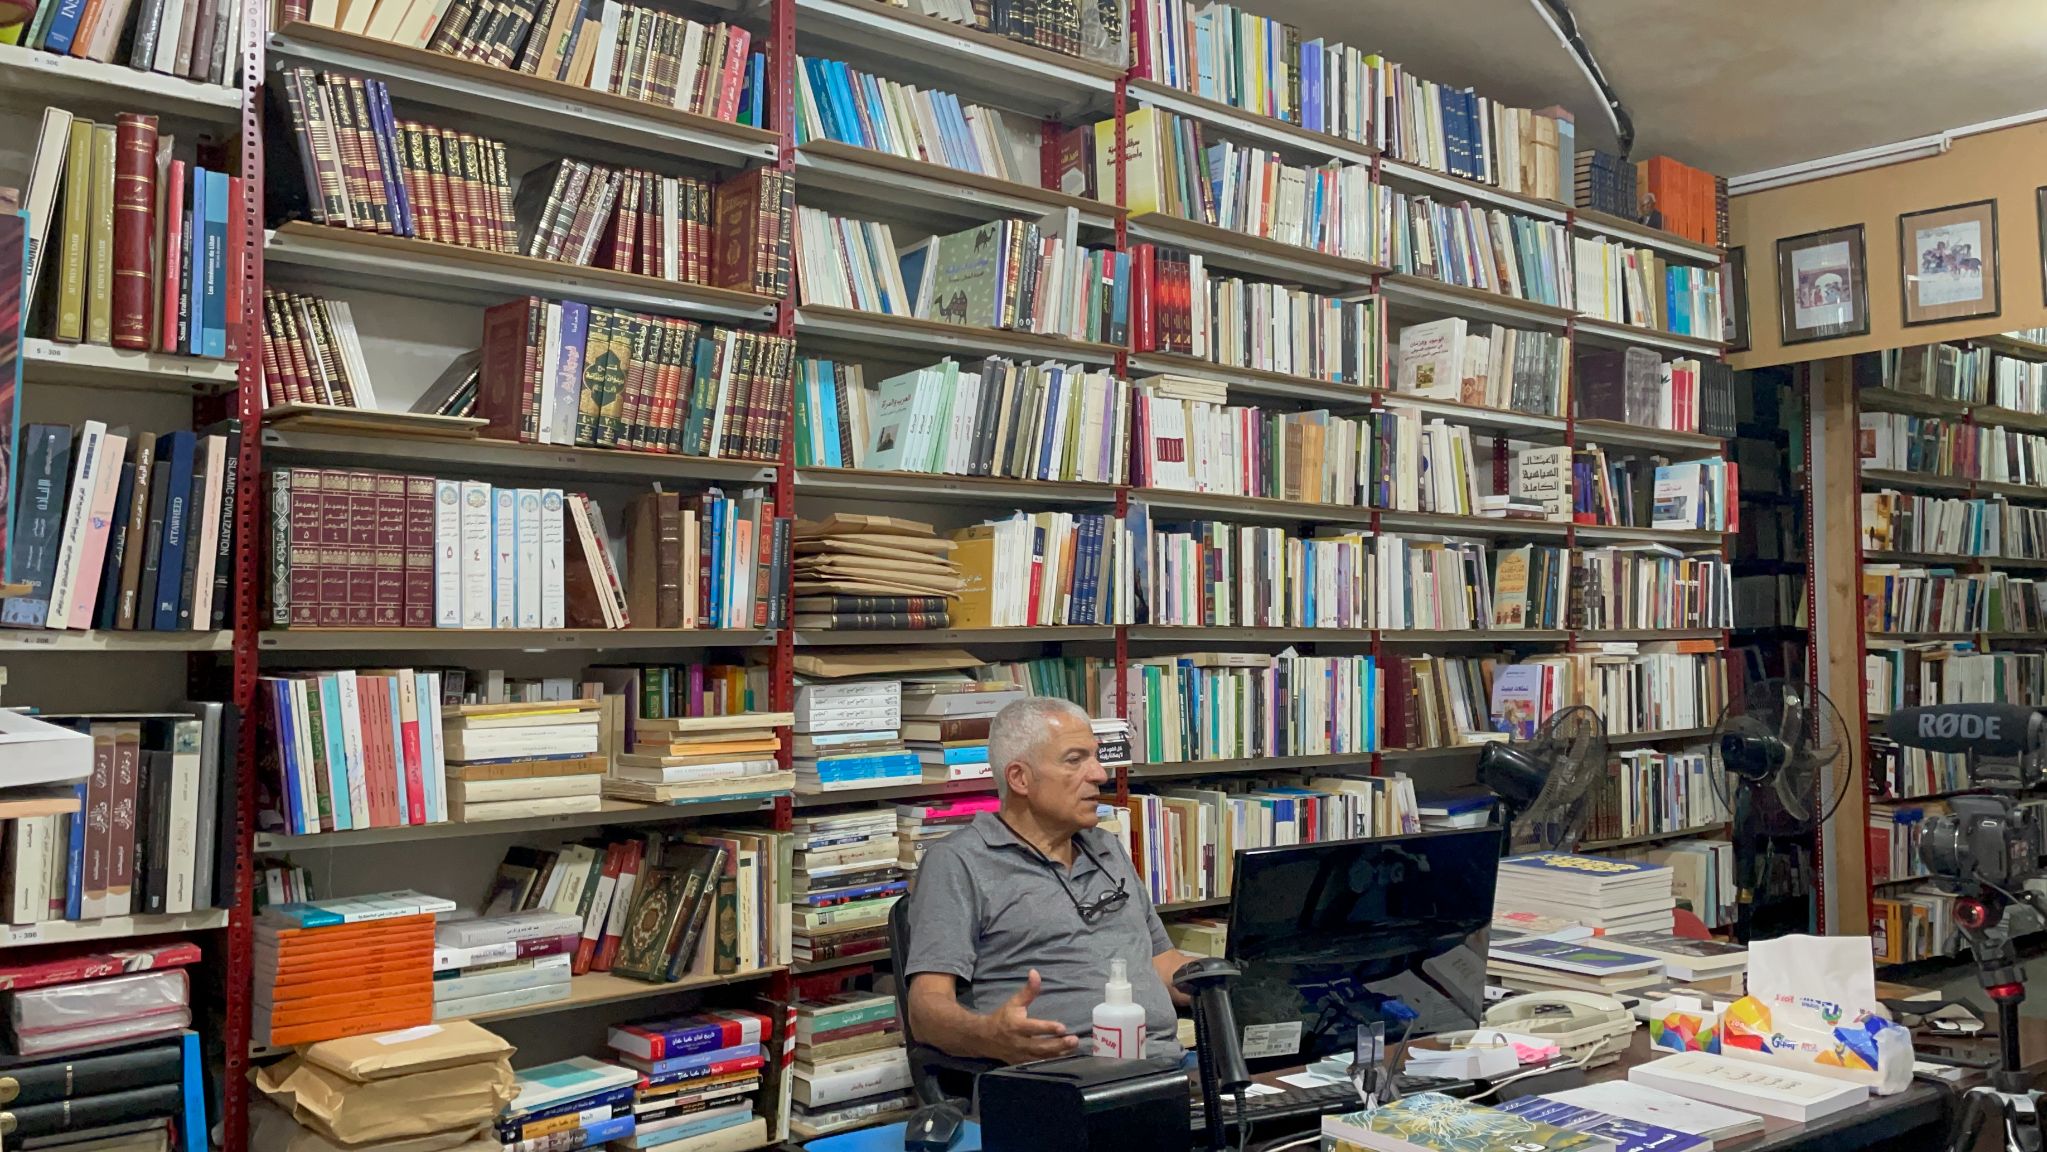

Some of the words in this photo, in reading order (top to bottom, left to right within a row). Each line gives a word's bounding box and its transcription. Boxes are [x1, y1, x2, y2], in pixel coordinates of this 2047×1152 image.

[179, 294, 187, 317] Arabia
[179, 322, 187, 341] Saudi
[226, 457, 239, 494] ISLAMIC
[169, 497, 182, 545] ATTAWHEED
[220, 495, 234, 556] CIVILIZATION
[304, 531, 309, 539] ٥
[446, 546, 453, 558] ٥
[474, 549, 480, 562] ٤
[501, 552, 510, 564] ٣
[551, 558, 556, 569] ١
[1918, 713, 2002, 740] RØDE
[694, 1034, 703, 1042] لبنان
[703, 1032, 715, 1040] تاريخ
[1101, 1036, 1117, 1050] PUR
